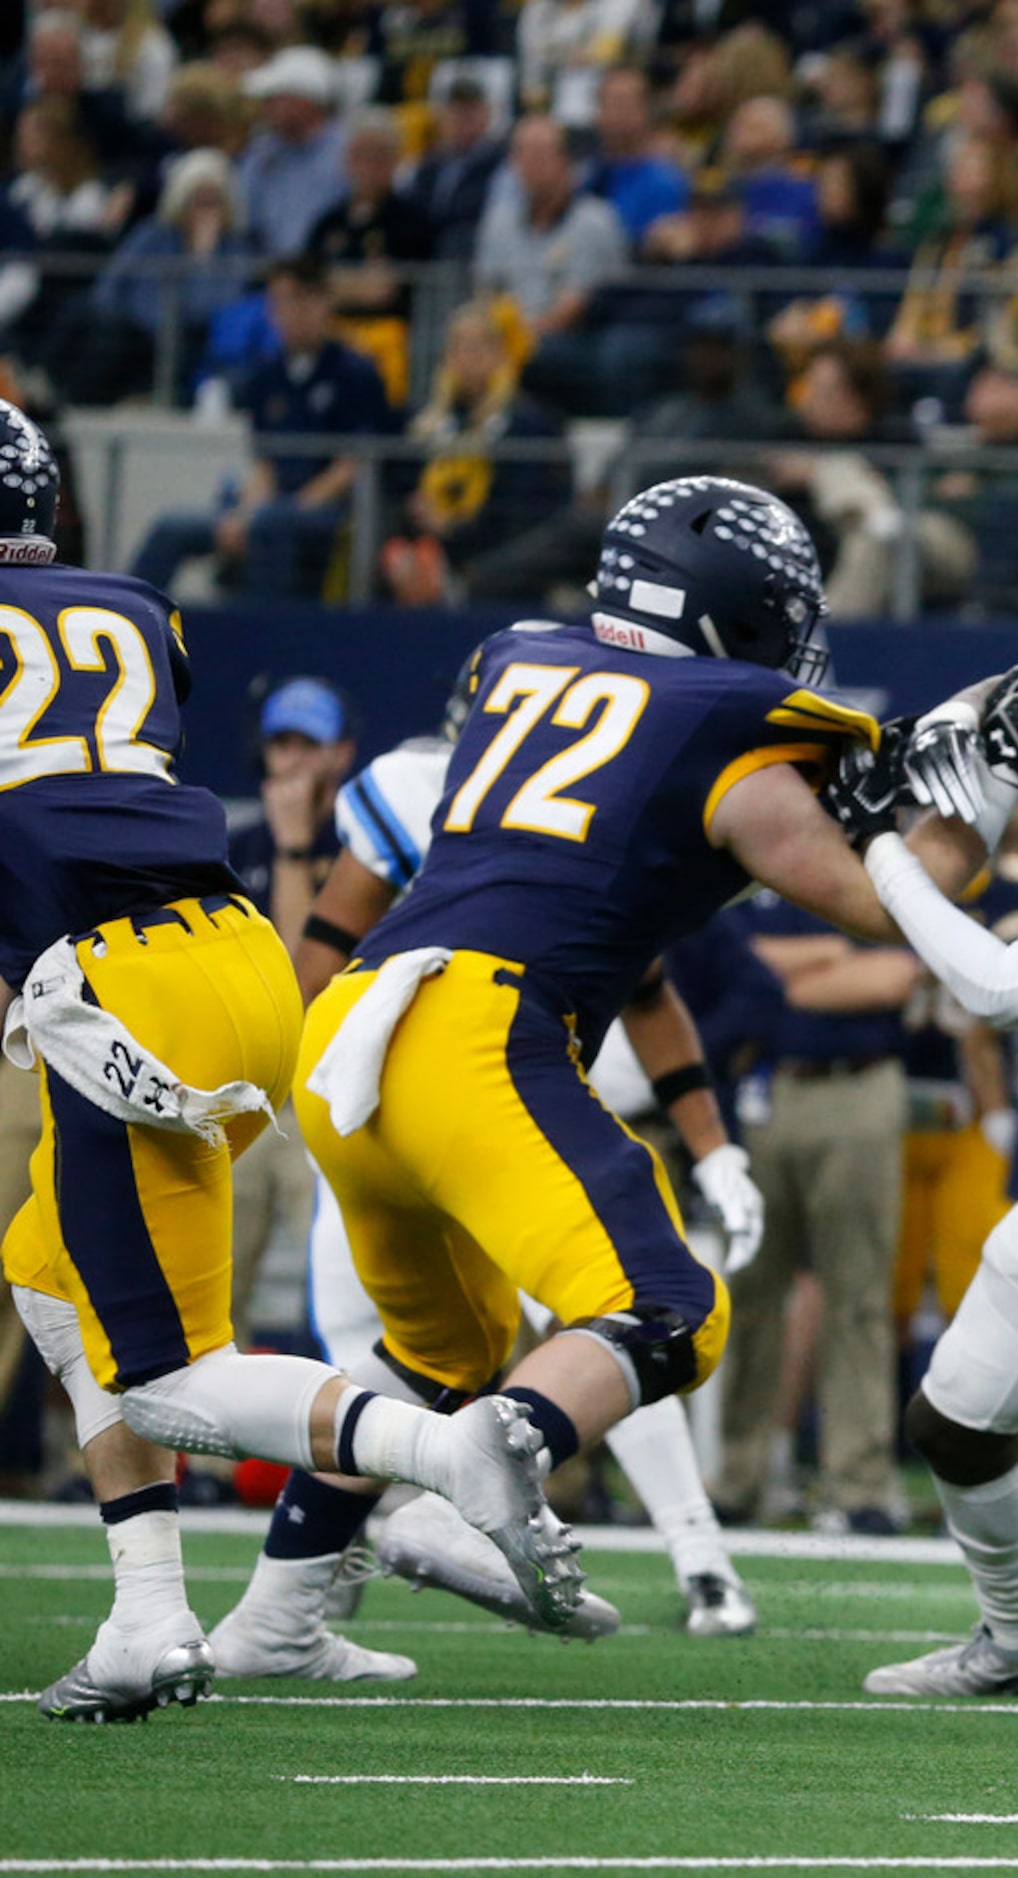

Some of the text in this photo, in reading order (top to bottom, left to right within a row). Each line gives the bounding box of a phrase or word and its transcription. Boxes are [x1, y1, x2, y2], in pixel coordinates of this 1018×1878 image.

[0, 603, 178, 793] 22
[442, 662, 652, 844] 72
[103, 1039, 144, 1099] 22
